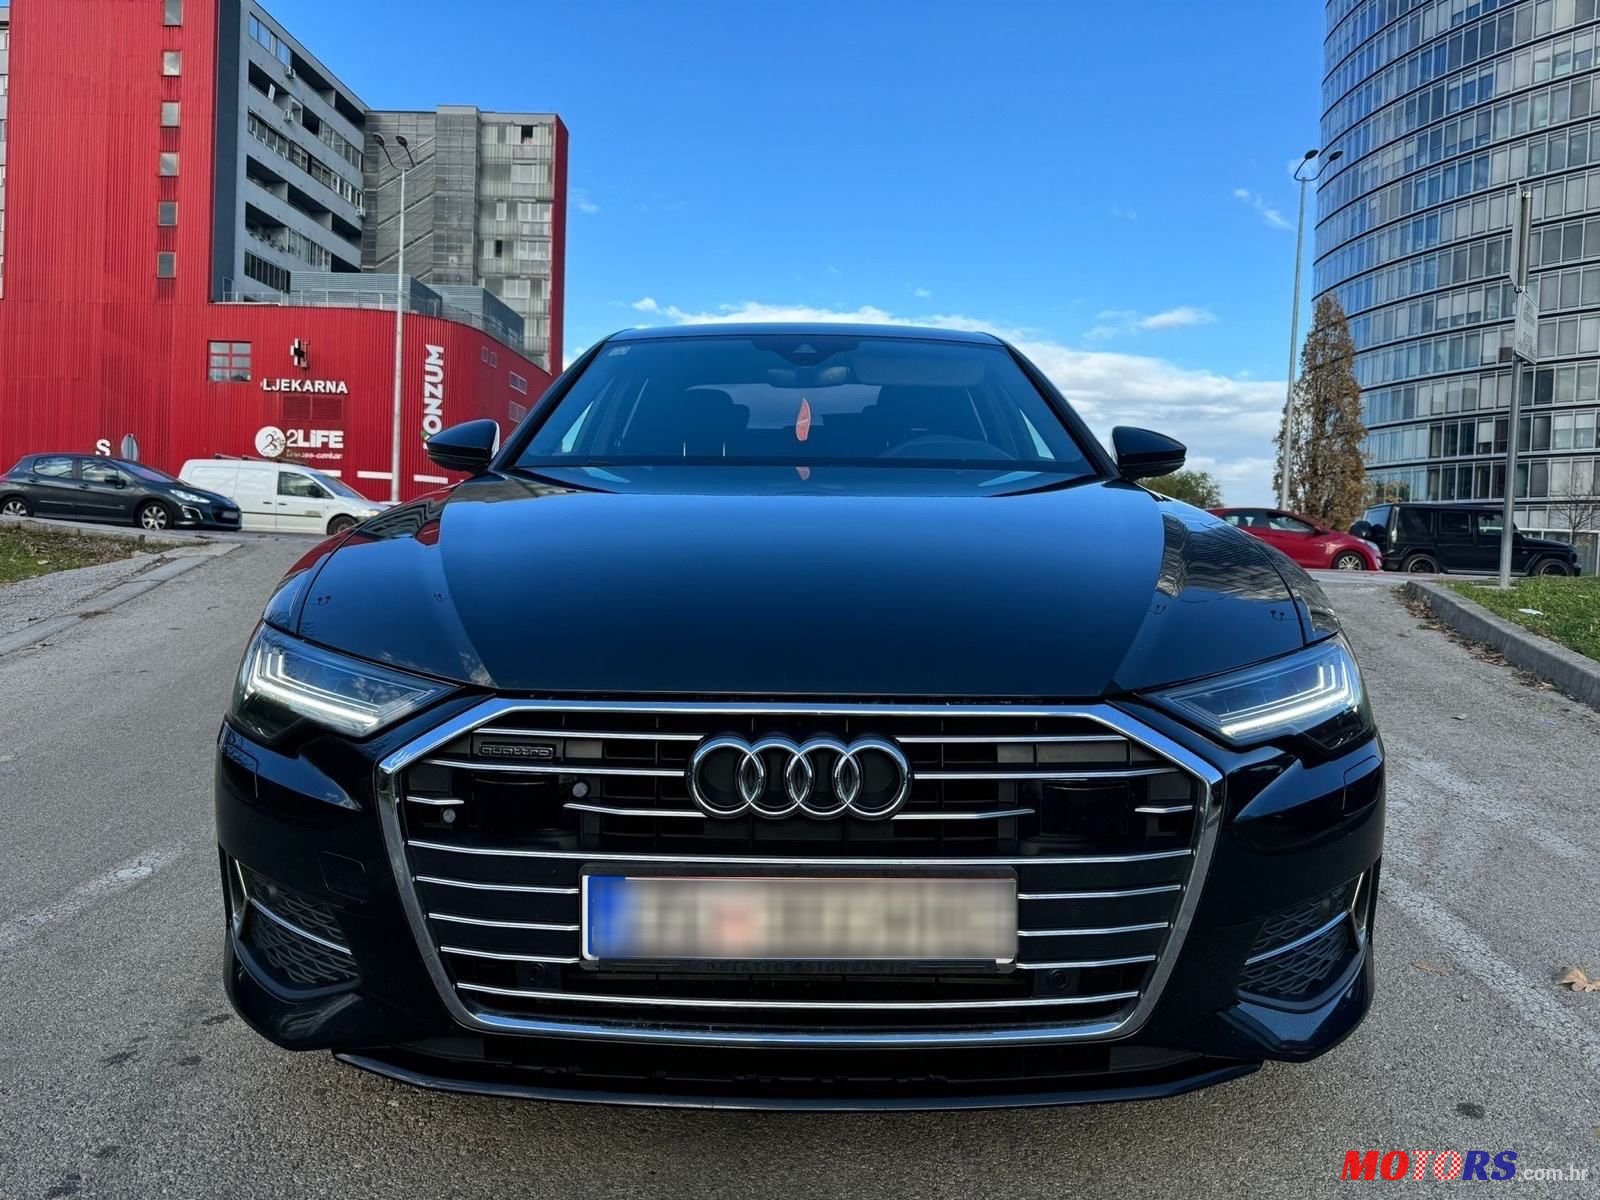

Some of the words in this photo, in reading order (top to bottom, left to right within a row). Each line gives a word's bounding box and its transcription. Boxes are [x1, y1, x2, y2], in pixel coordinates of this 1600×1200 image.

[262, 378, 348, 394] LJEKARNA
[286, 429, 344, 448] 2LIFE
[481, 746, 550, 757] quattro
